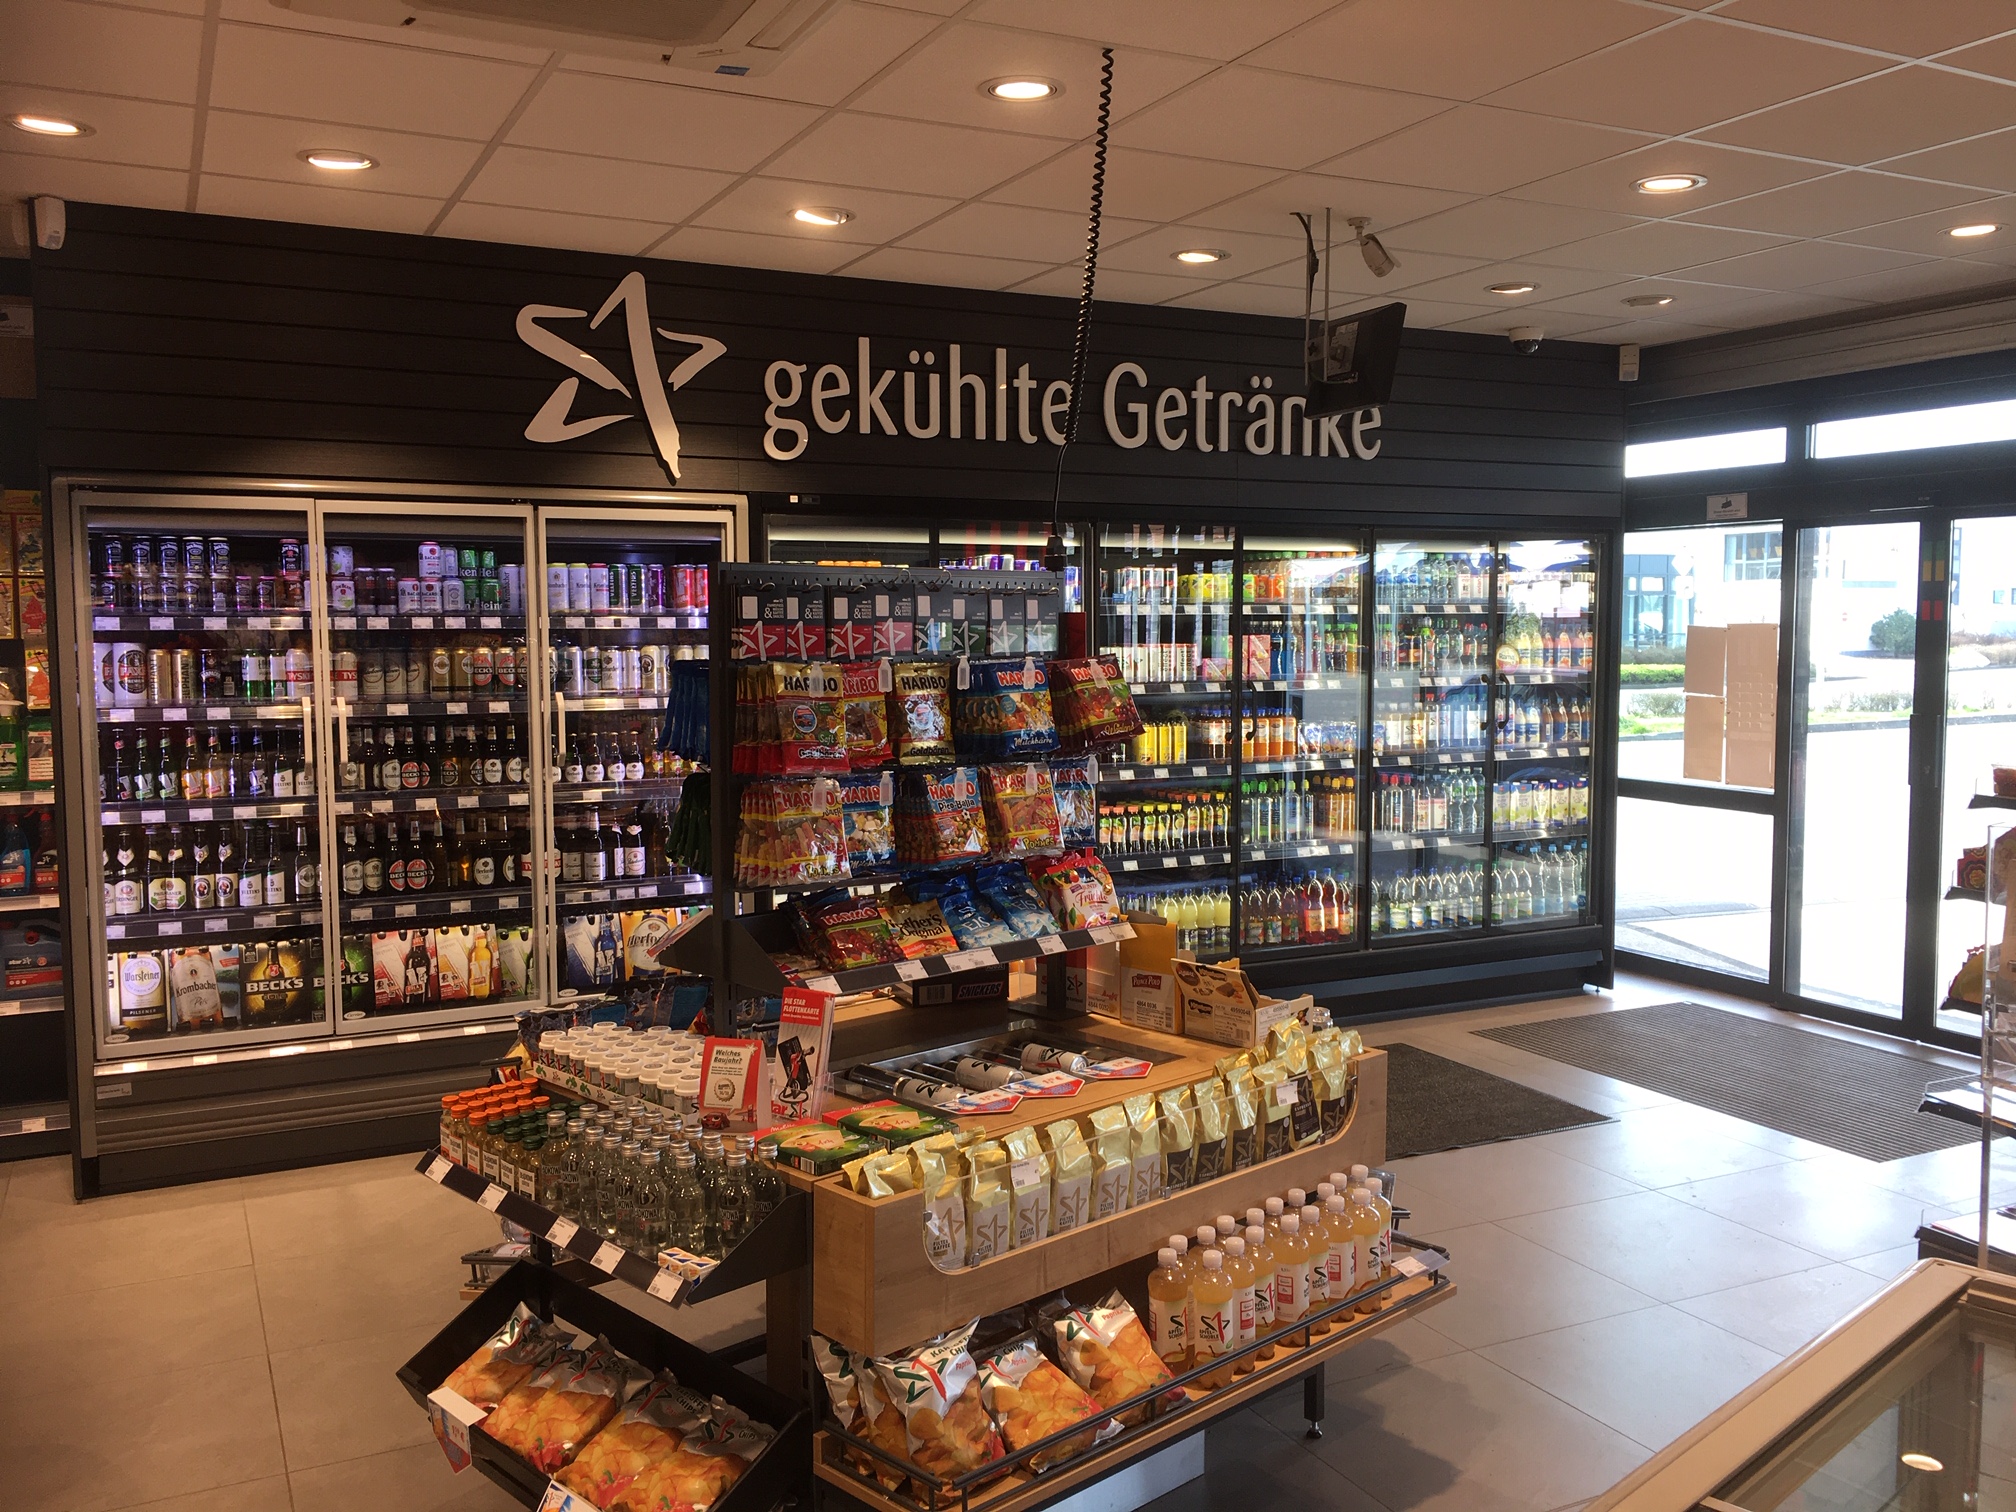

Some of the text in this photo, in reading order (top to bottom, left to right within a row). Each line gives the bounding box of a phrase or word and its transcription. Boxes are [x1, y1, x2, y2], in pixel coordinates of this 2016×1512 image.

[764, 336, 1382, 461] gekühlte Getränke
[764, 607, 773, 619] &
[804, 608, 813, 619] &
[853, 608, 862, 619] &
[894, 605, 902, 617] &
[286, 672, 312, 681] TYSKI
[901, 675, 946, 690] HARIBO
[996, 670, 1045, 686] HARO
[910, 747, 950, 756] Goldbären
[1050, 767, 1088, 783] HARIB
[841, 785, 881, 804] HARIB
[928, 780, 975, 799] HARO
[938, 799, 975, 811] Pico-Balla
[962, 916, 991, 931] EIS
[901, 925, 947, 939] Original
[124, 971, 160, 983] Warsteiner
[313, 972, 370, 987] BCK'S
[175, 981, 218, 998] Krombacher
[246, 977, 304, 993] BECK'S
[958, 982, 1001, 998] SNICKERS
[783, 1005, 820, 1015] FLOTTENKARTE
[715, 1049, 741, 1057] Welches
[713, 1056, 743, 1065] Baujahr?
[1059, 1214, 1074, 1222] FILTER
[1059, 1217, 1075, 1226] KAFFEE
[1019, 1227, 1034, 1235] FILTER
[1019, 1231, 1035, 1239] KAFFEE
[933, 1239, 949, 1248] FILTER
[933, 1243, 951, 1251] KAFFEE
[977, 1244, 993, 1252] FILTER
[1101, 1308, 1124, 1321] Paprika
[950, 1344, 966, 1357] CHI
[1003, 1342, 1024, 1355] CHIPS
[1011, 1357, 1028, 1367] Paprika
[675, 1385, 707, 1412] KARTOFFE
[676, 1397, 697, 1415] CHIPS
